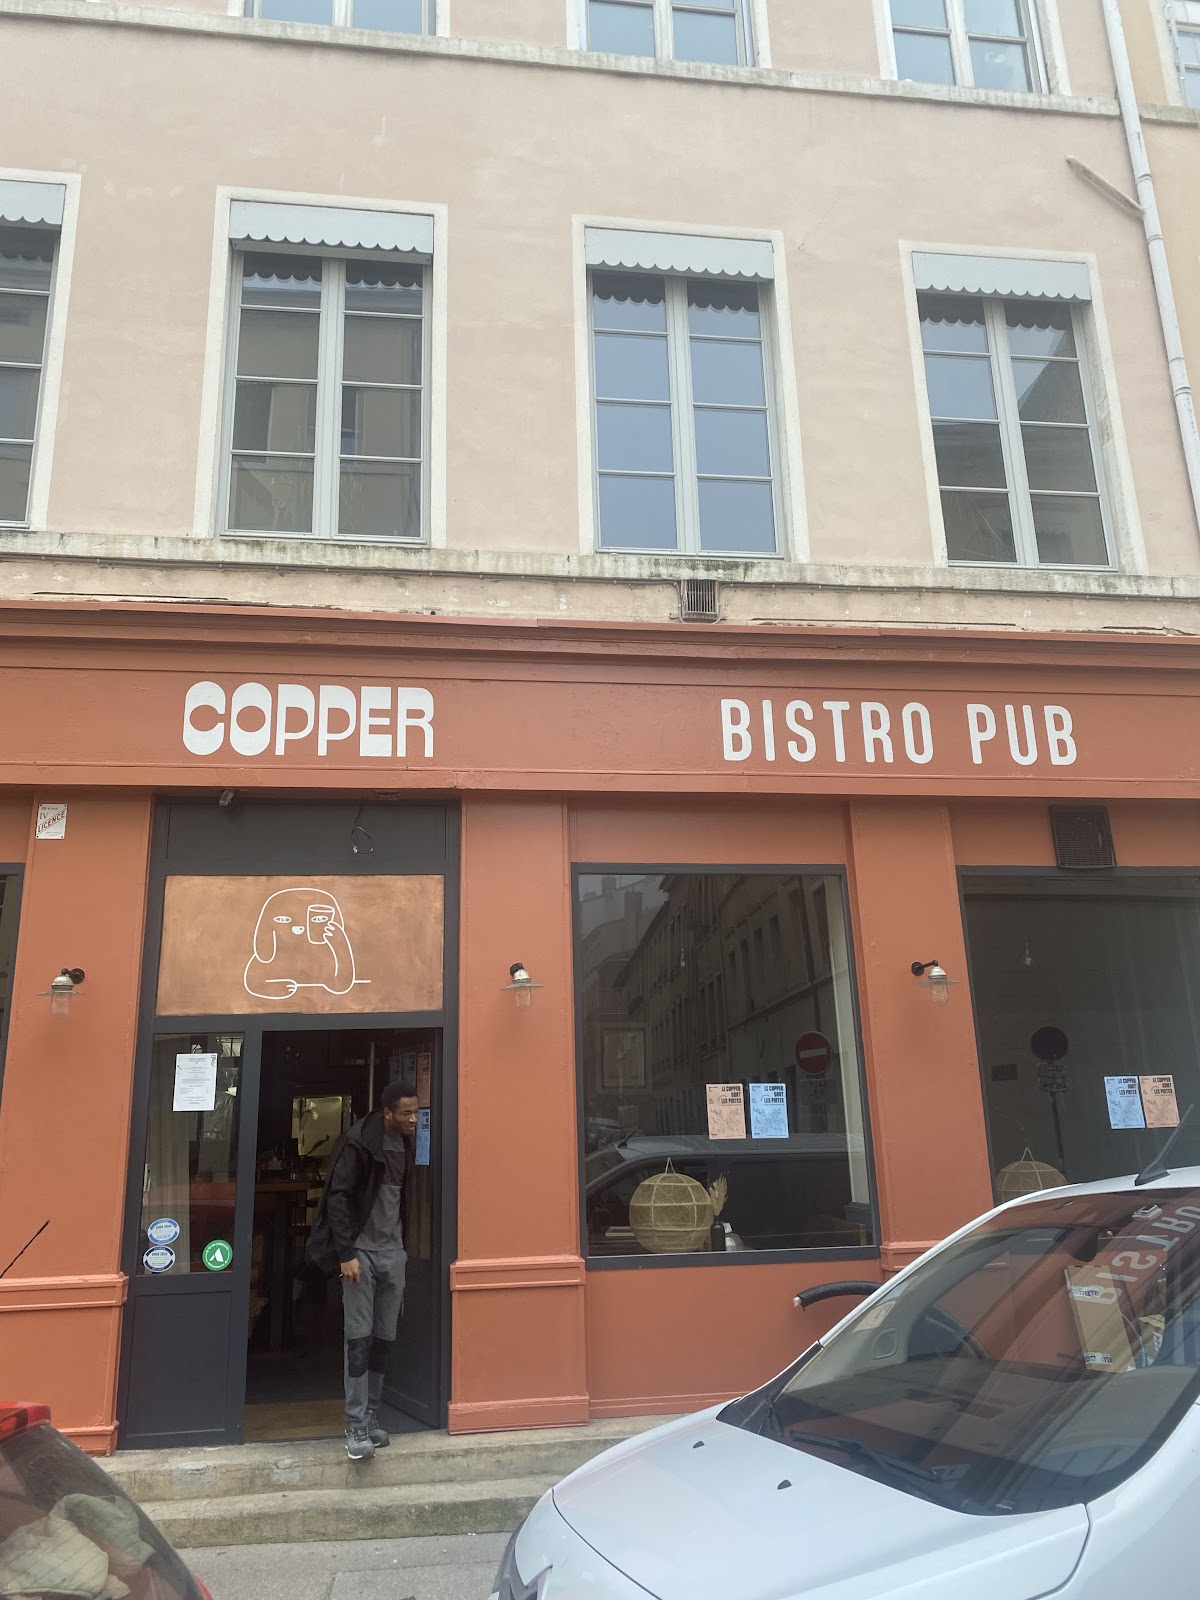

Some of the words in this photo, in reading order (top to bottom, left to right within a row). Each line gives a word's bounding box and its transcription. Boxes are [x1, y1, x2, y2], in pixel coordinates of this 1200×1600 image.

[183, 680, 434, 757] COPPER
[721, 698, 934, 764] BISTRO
[967, 703, 1077, 766] PUB
[38, 810, 65, 832] LICENCE
